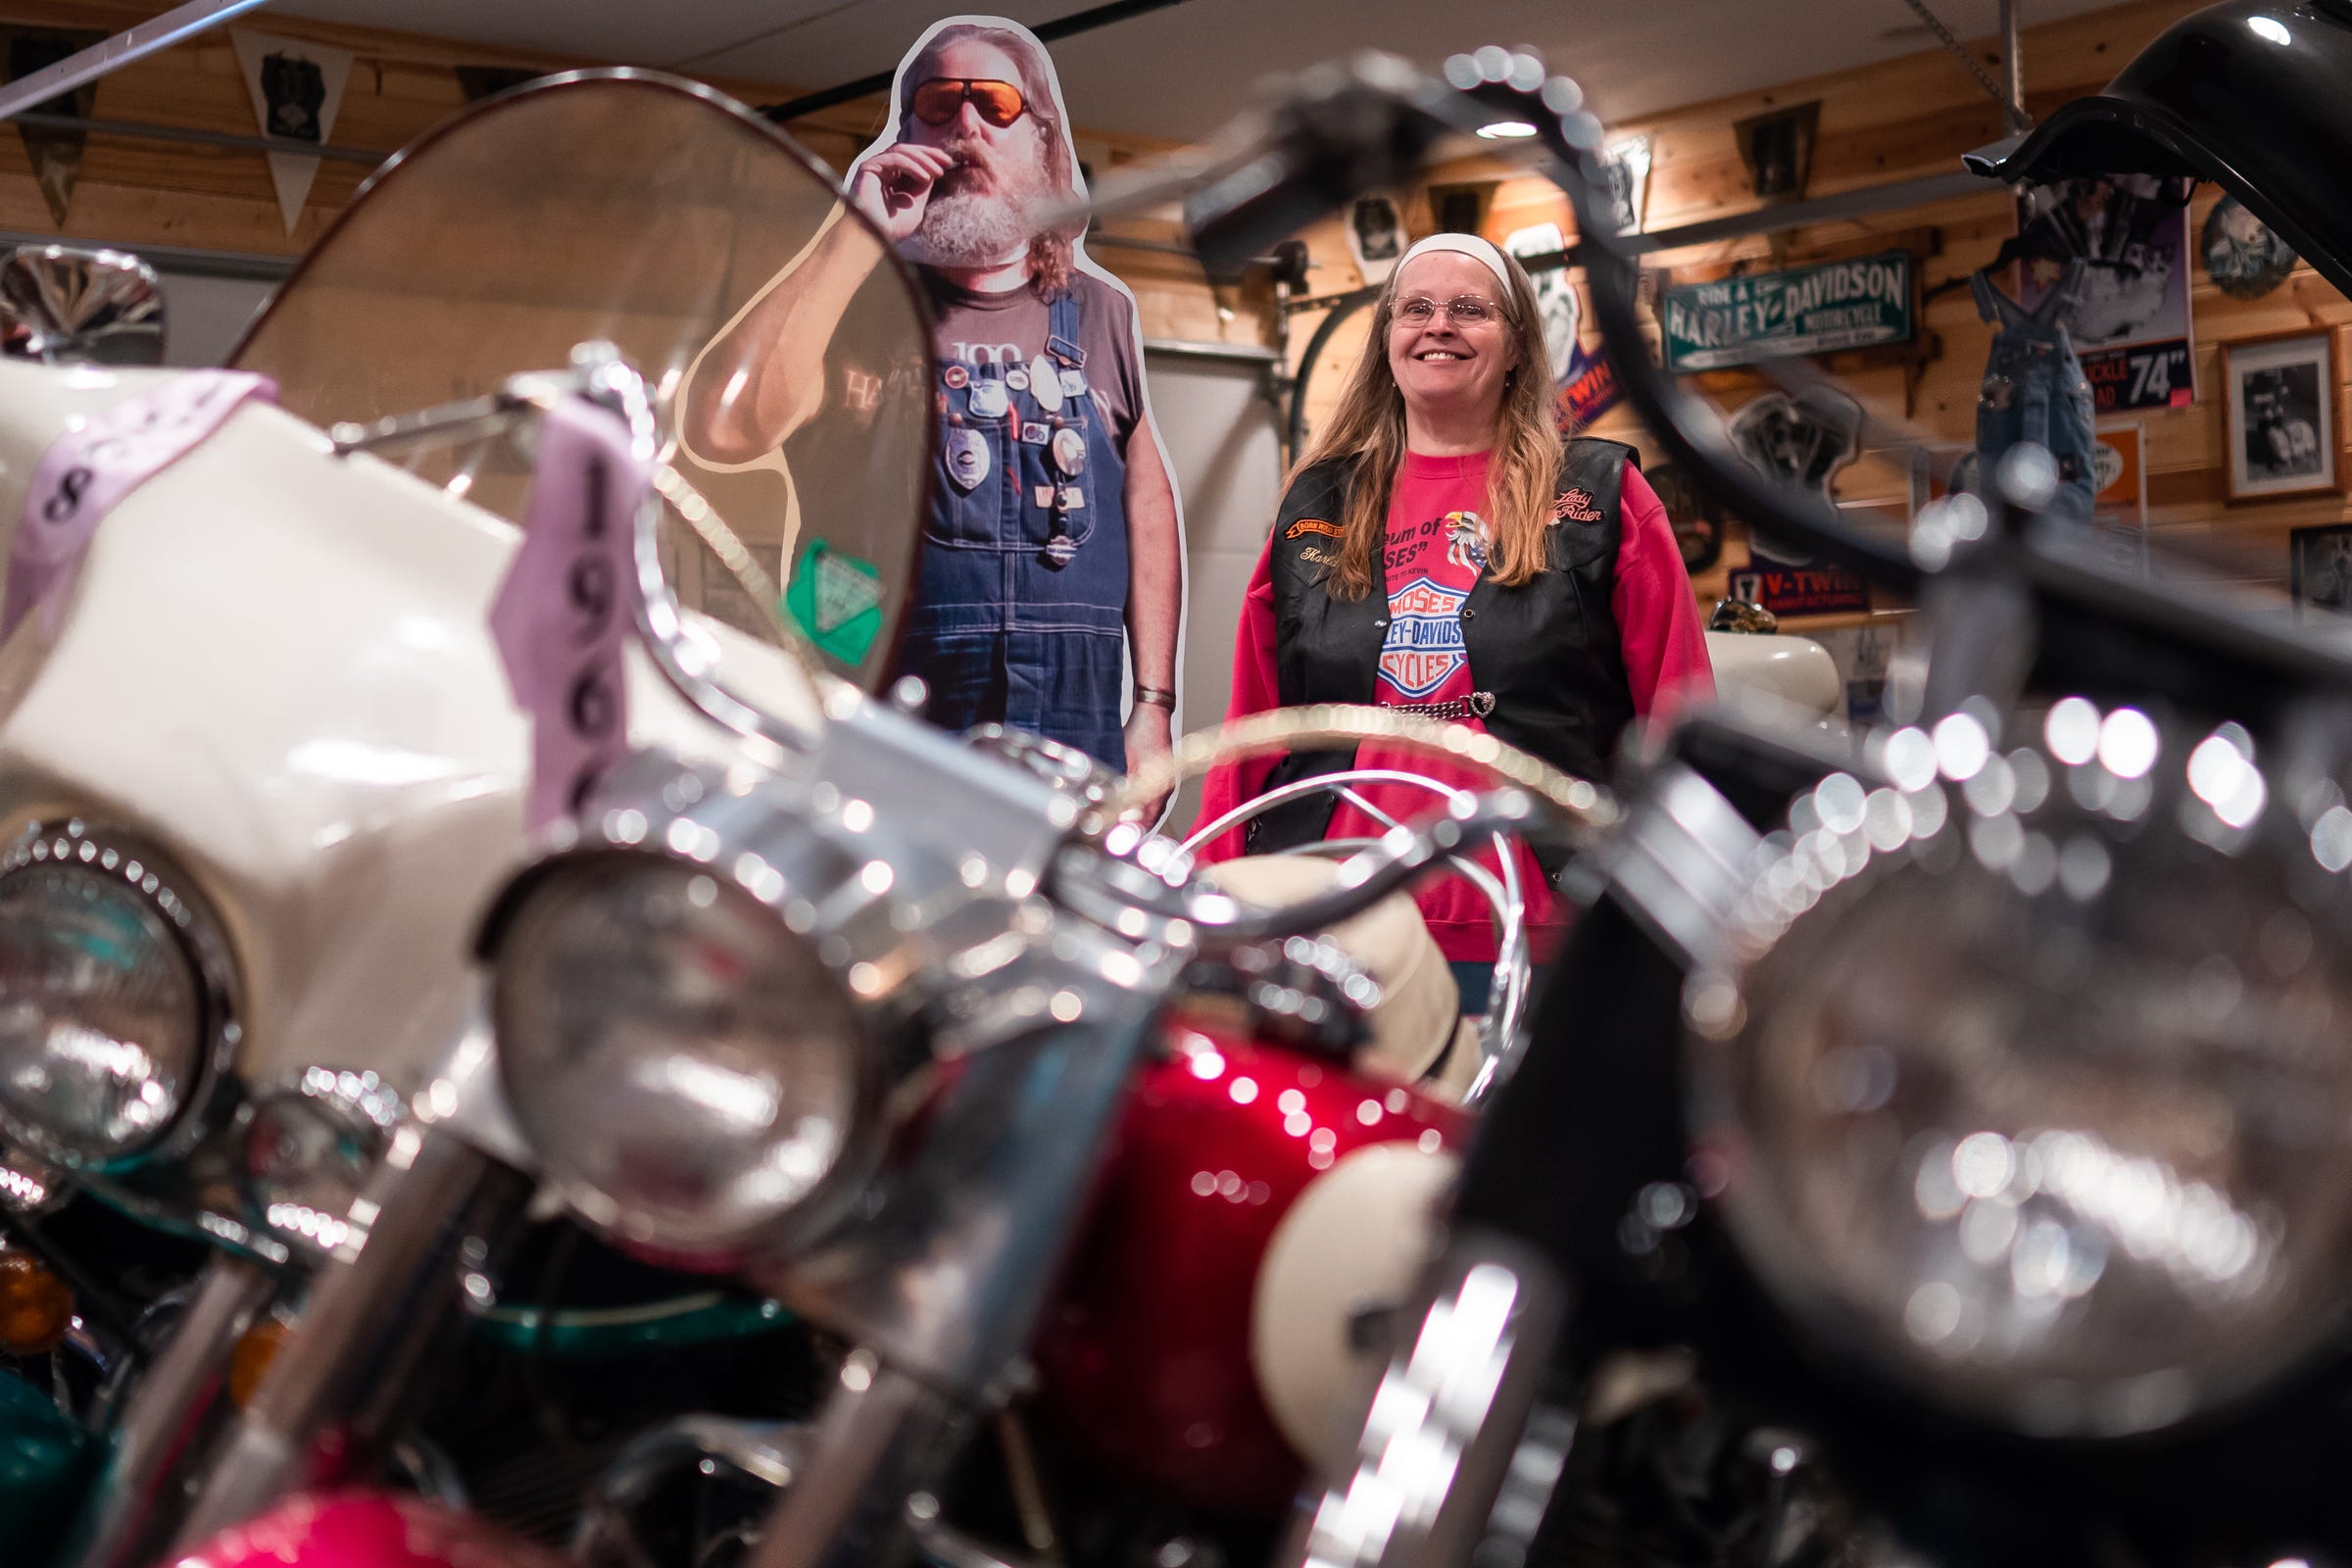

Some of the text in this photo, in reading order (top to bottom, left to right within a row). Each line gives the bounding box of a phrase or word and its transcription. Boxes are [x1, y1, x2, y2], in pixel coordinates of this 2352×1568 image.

[1552, 488, 1592, 509] Lady
[1555, 505, 1602, 522] Rider
[1299, 521, 1318, 531] BORN
[1420, 516, 1443, 536] of
[1407, 566, 1429, 575] KEVIN
[1388, 586, 1456, 615] MOSES
[1382, 653, 1449, 689] CYCLES
